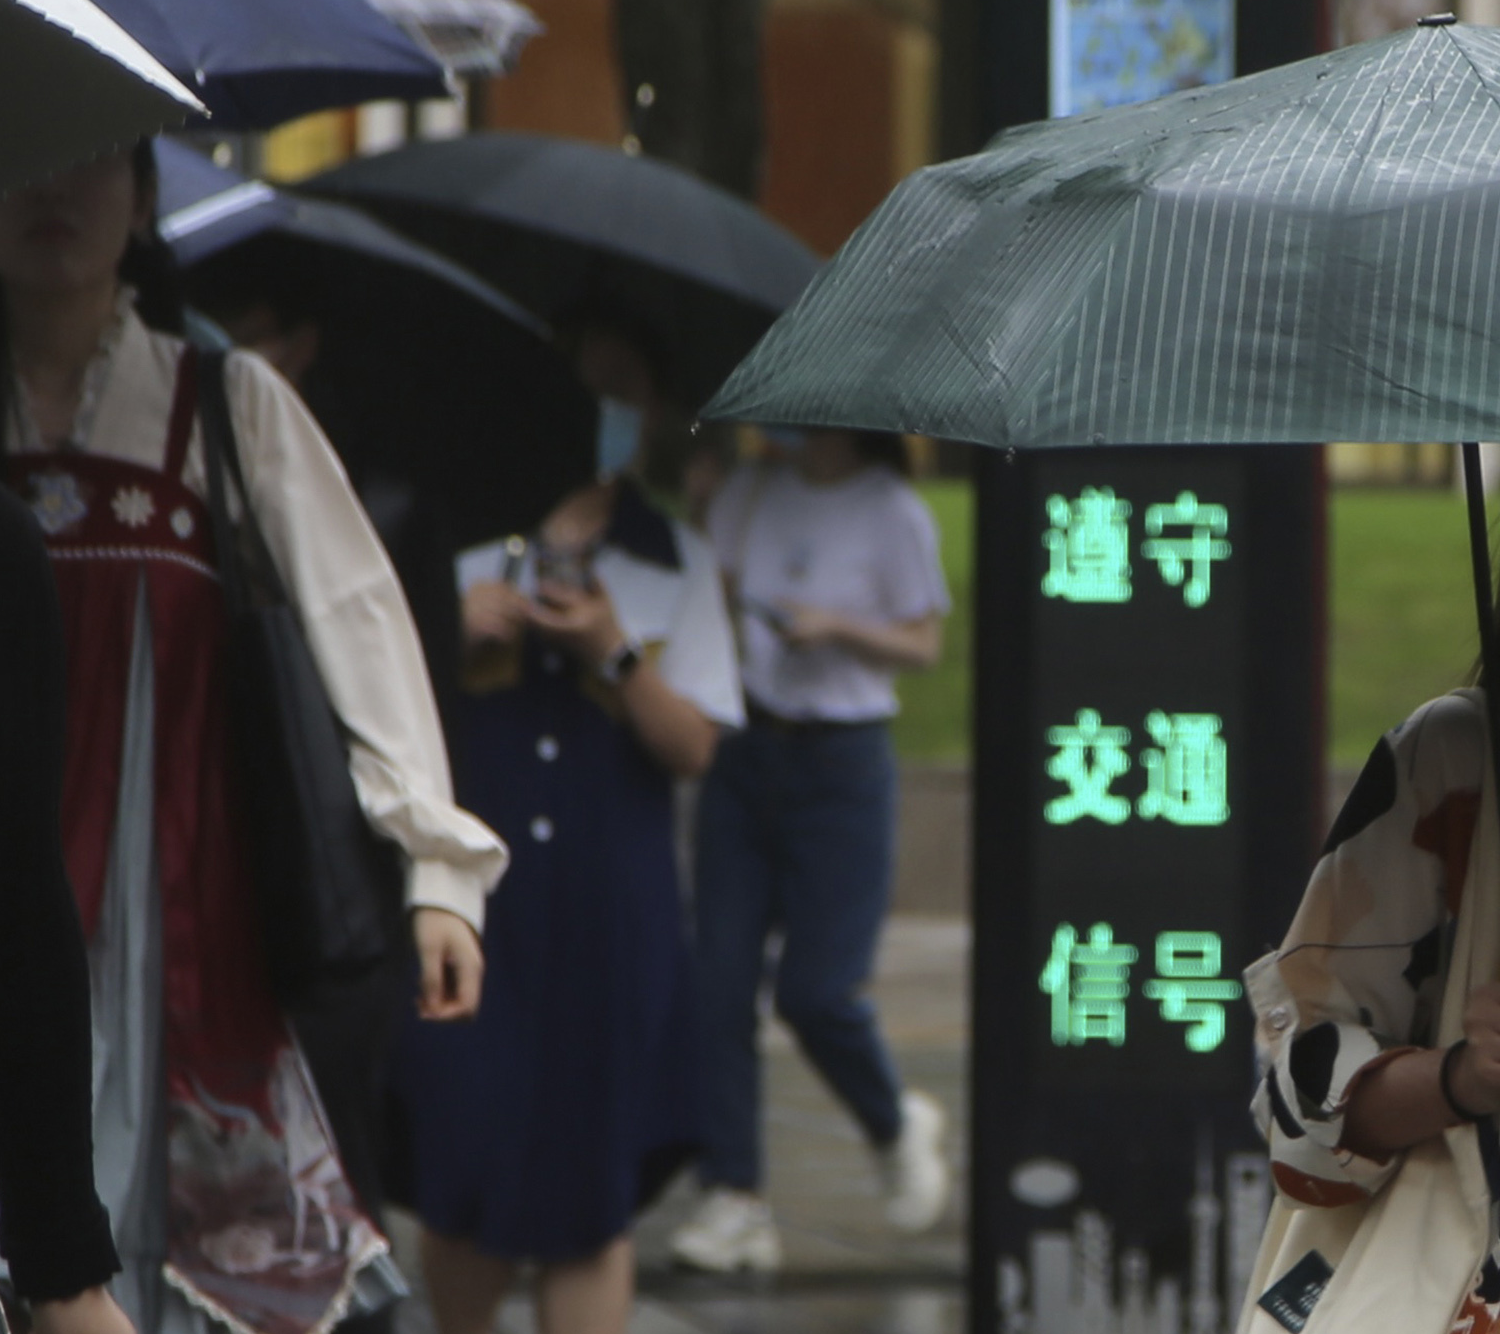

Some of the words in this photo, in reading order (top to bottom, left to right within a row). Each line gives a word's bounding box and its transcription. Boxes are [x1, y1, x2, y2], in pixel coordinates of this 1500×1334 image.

[1041, 487, 1232, 608] 遵守
[1043, 708, 1232, 826] 交通
[1038, 922, 1241, 1053] 信号
